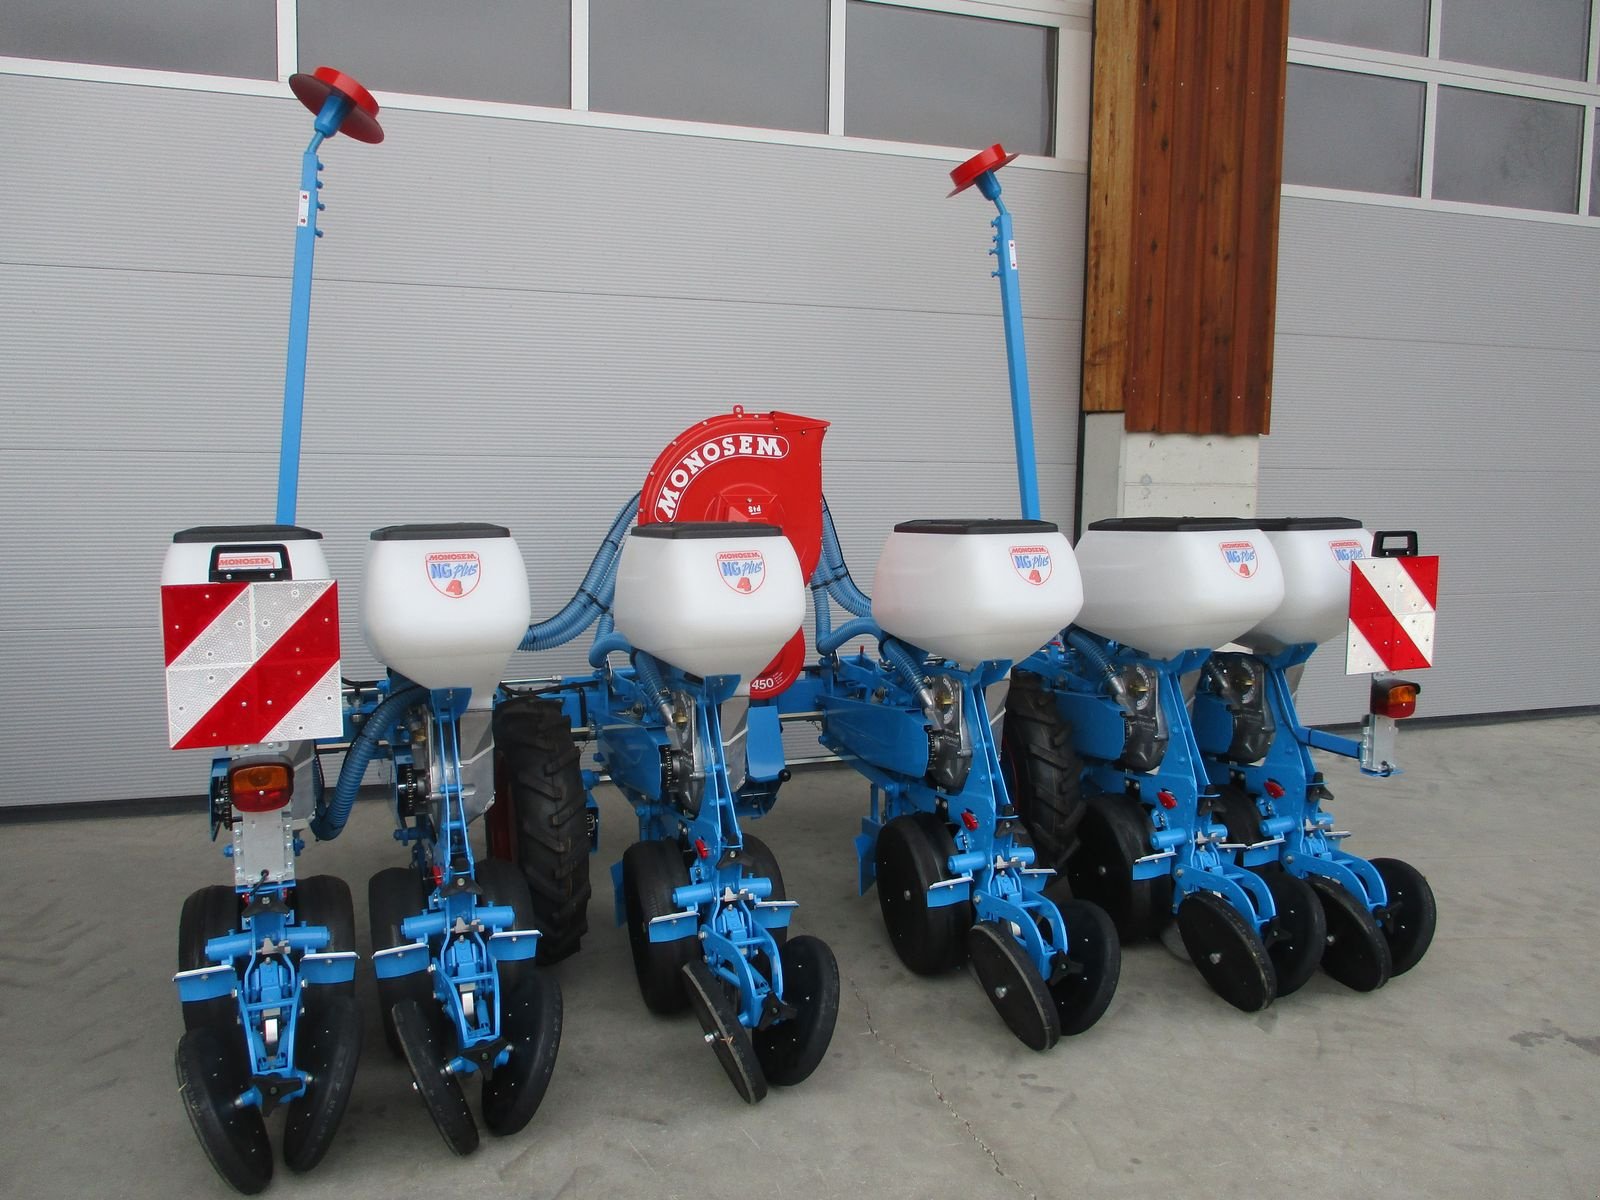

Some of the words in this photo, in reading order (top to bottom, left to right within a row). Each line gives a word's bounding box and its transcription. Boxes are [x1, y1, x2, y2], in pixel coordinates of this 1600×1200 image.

[658, 436, 782, 519] MONOSEM
[428, 553, 476, 561] MONOSEM
[1015, 555, 1032, 568] NG
[1226, 550, 1240, 563] NG
[431, 563, 452, 579] NG
[722, 561, 741, 576] NG
[1028, 569, 1042, 583] 4
[446, 579, 463, 595] 4
[736, 577, 752, 592] 4
[751, 678, 774, 690] 450
